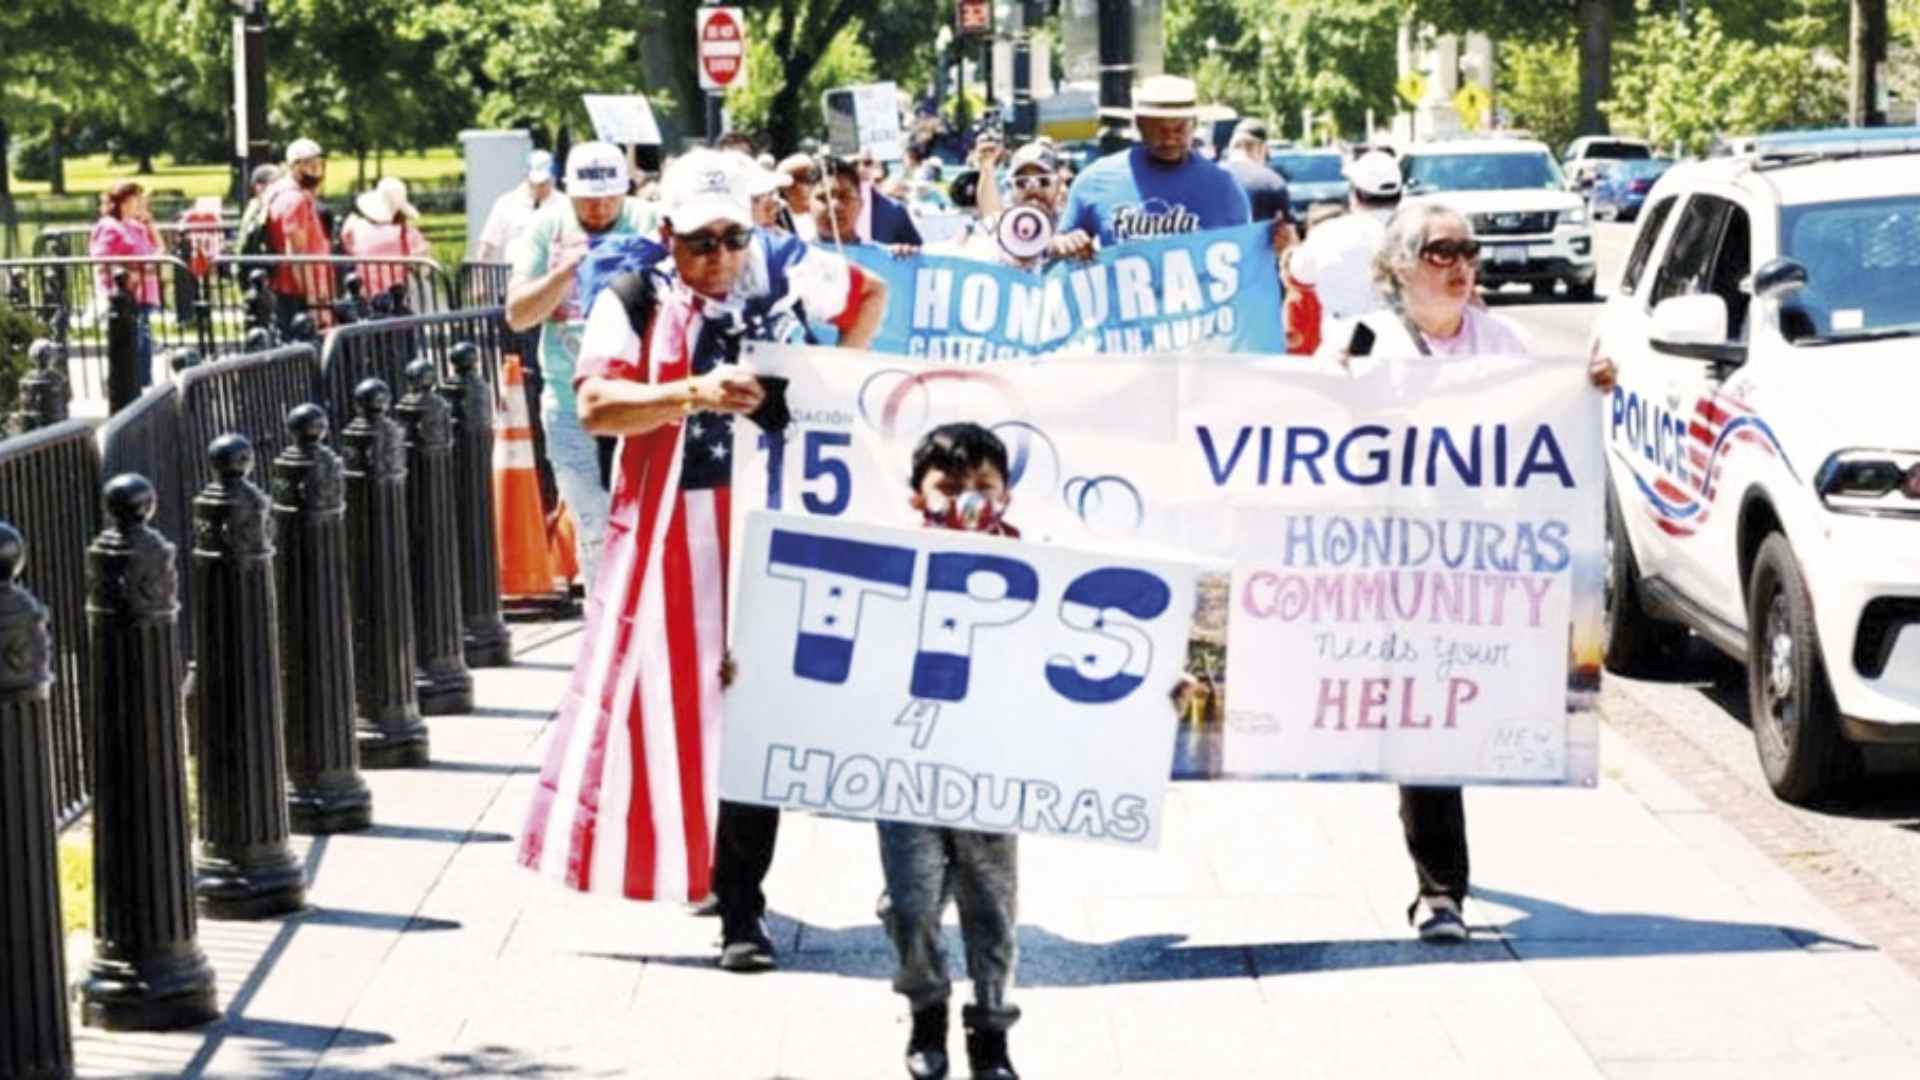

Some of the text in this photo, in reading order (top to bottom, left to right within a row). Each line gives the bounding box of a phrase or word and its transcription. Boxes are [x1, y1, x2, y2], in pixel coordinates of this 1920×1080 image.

[1196, 424, 1576, 488] VIRGINIA
[1612, 384, 1688, 482] POLICE
[757, 430, 851, 516] 15
[1282, 514, 1571, 573] HONDURAS
[767, 528, 1171, 704] TPS
[1242, 570, 1555, 628] COMMUNITY
[894, 701, 941, 749] 4
[1313, 676, 1480, 731] HELP
[762, 743, 1150, 843] HONDURAS
